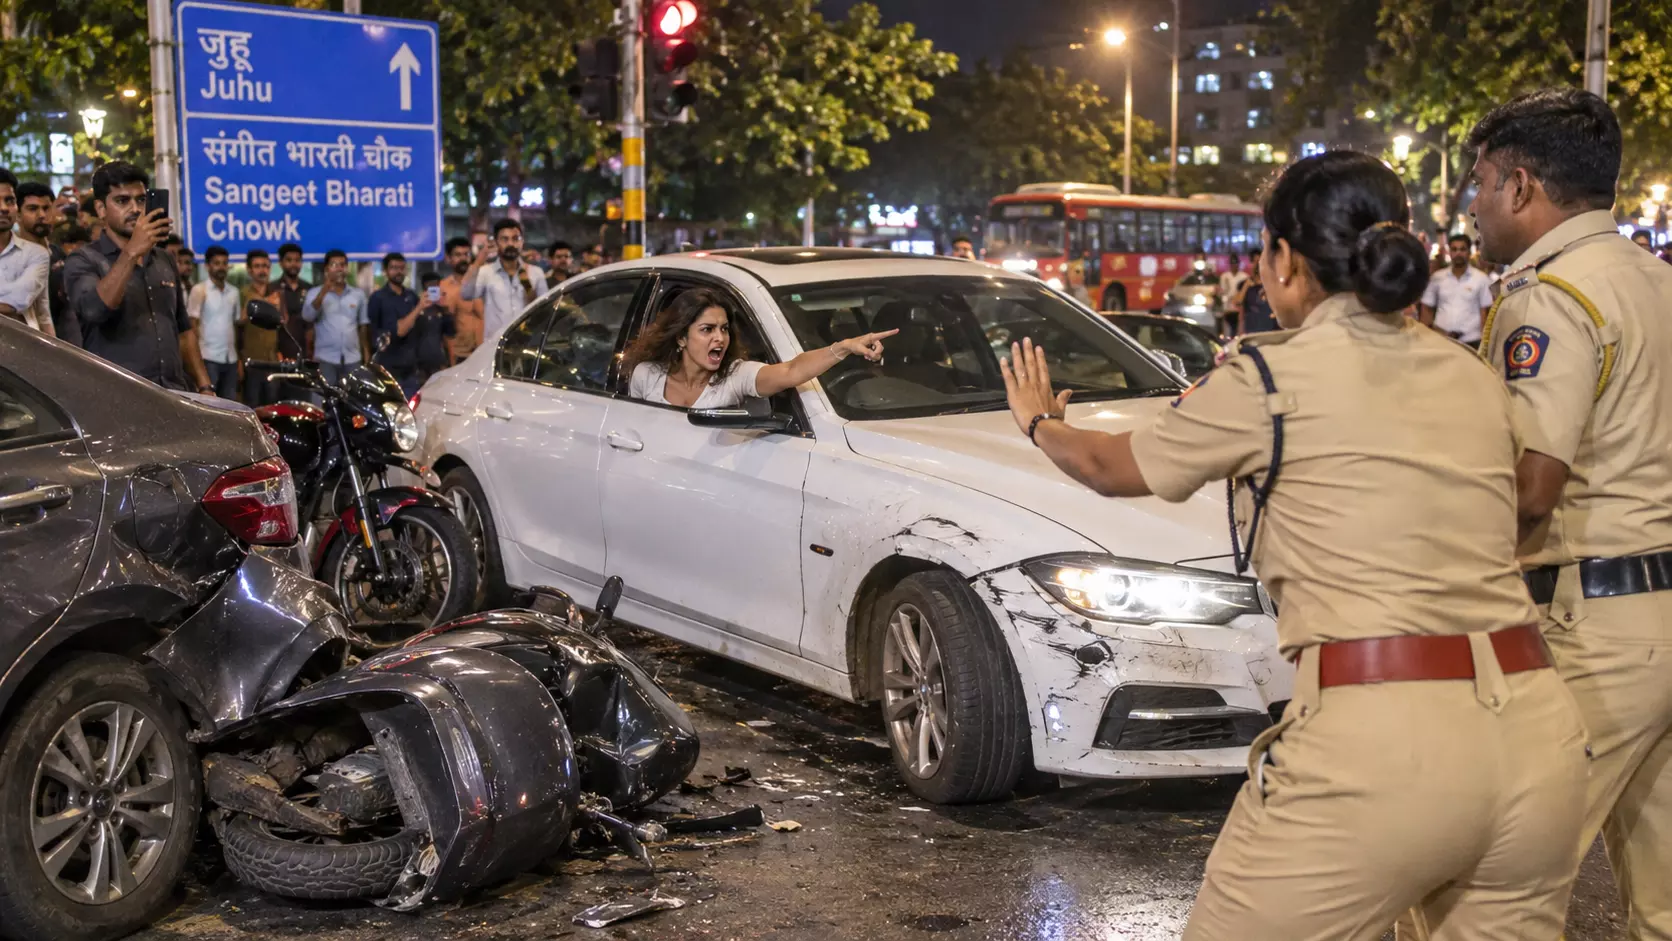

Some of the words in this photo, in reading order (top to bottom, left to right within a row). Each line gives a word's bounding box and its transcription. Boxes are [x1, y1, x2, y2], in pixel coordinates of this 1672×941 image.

[197, 28, 253, 72] जुहू
[201, 71, 272, 102] Juhu
[202, 129, 276, 166] संगीत
[286, 134, 355, 169] भारती
[362, 136, 412, 170] चौक
[205, 176, 317, 211] Sangeet
[326, 180, 413, 207] Bharati
[207, 213, 300, 240] Chowk
